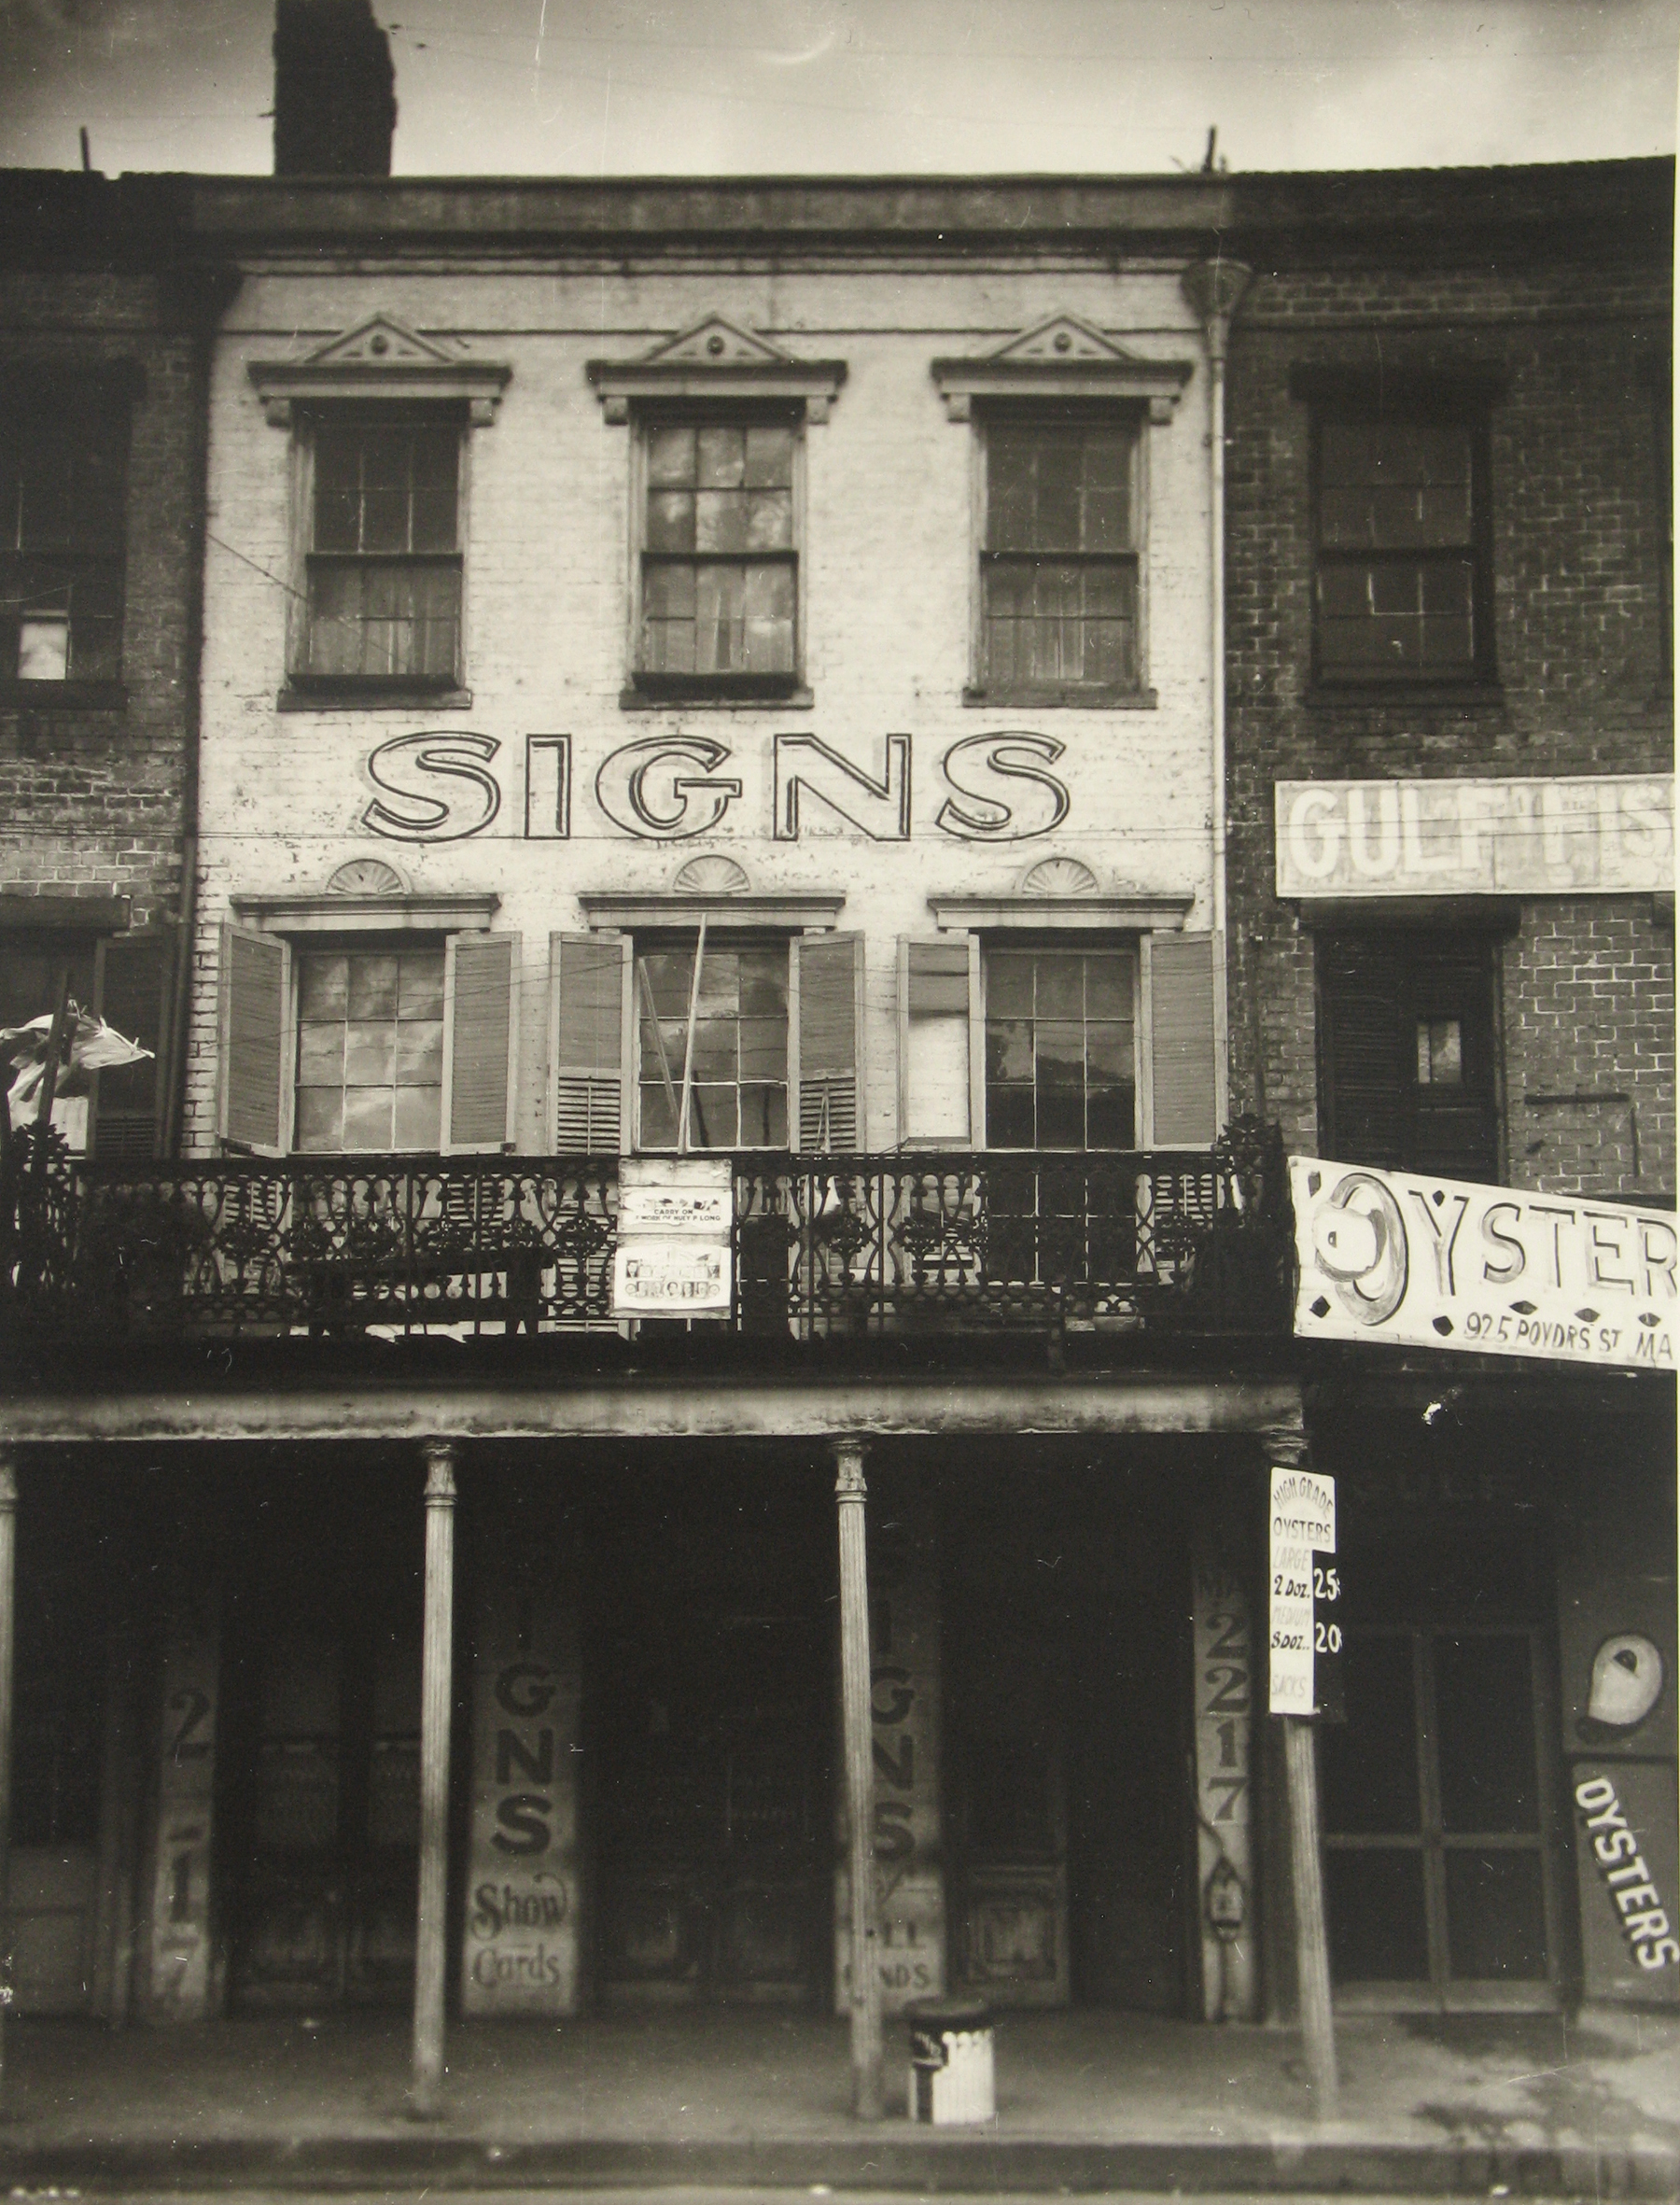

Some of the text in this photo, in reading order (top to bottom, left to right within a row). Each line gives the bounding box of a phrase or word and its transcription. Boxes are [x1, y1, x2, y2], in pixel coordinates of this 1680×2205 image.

[360, 731, 1073, 842] SIGNS
[1289, 782, 1675, 878] GULF FIS
[1313, 1173, 1676, 1327] OYSTER
[1464, 1312, 1513, 1341] 925
[1599, 1328, 1622, 1352] ST
[1273, 1476, 1334, 1520] HIGH GRADE
[1273, 1516, 1331, 1543] OYSTERS
[1274, 1574, 1283, 1595] 2
[1205, 1613, 1250, 1824] 2217
[470, 1874, 567, 1940] Show
[1575, 1777, 1679, 1971] OYSTERS
[470, 1942, 562, 1990] Cards
